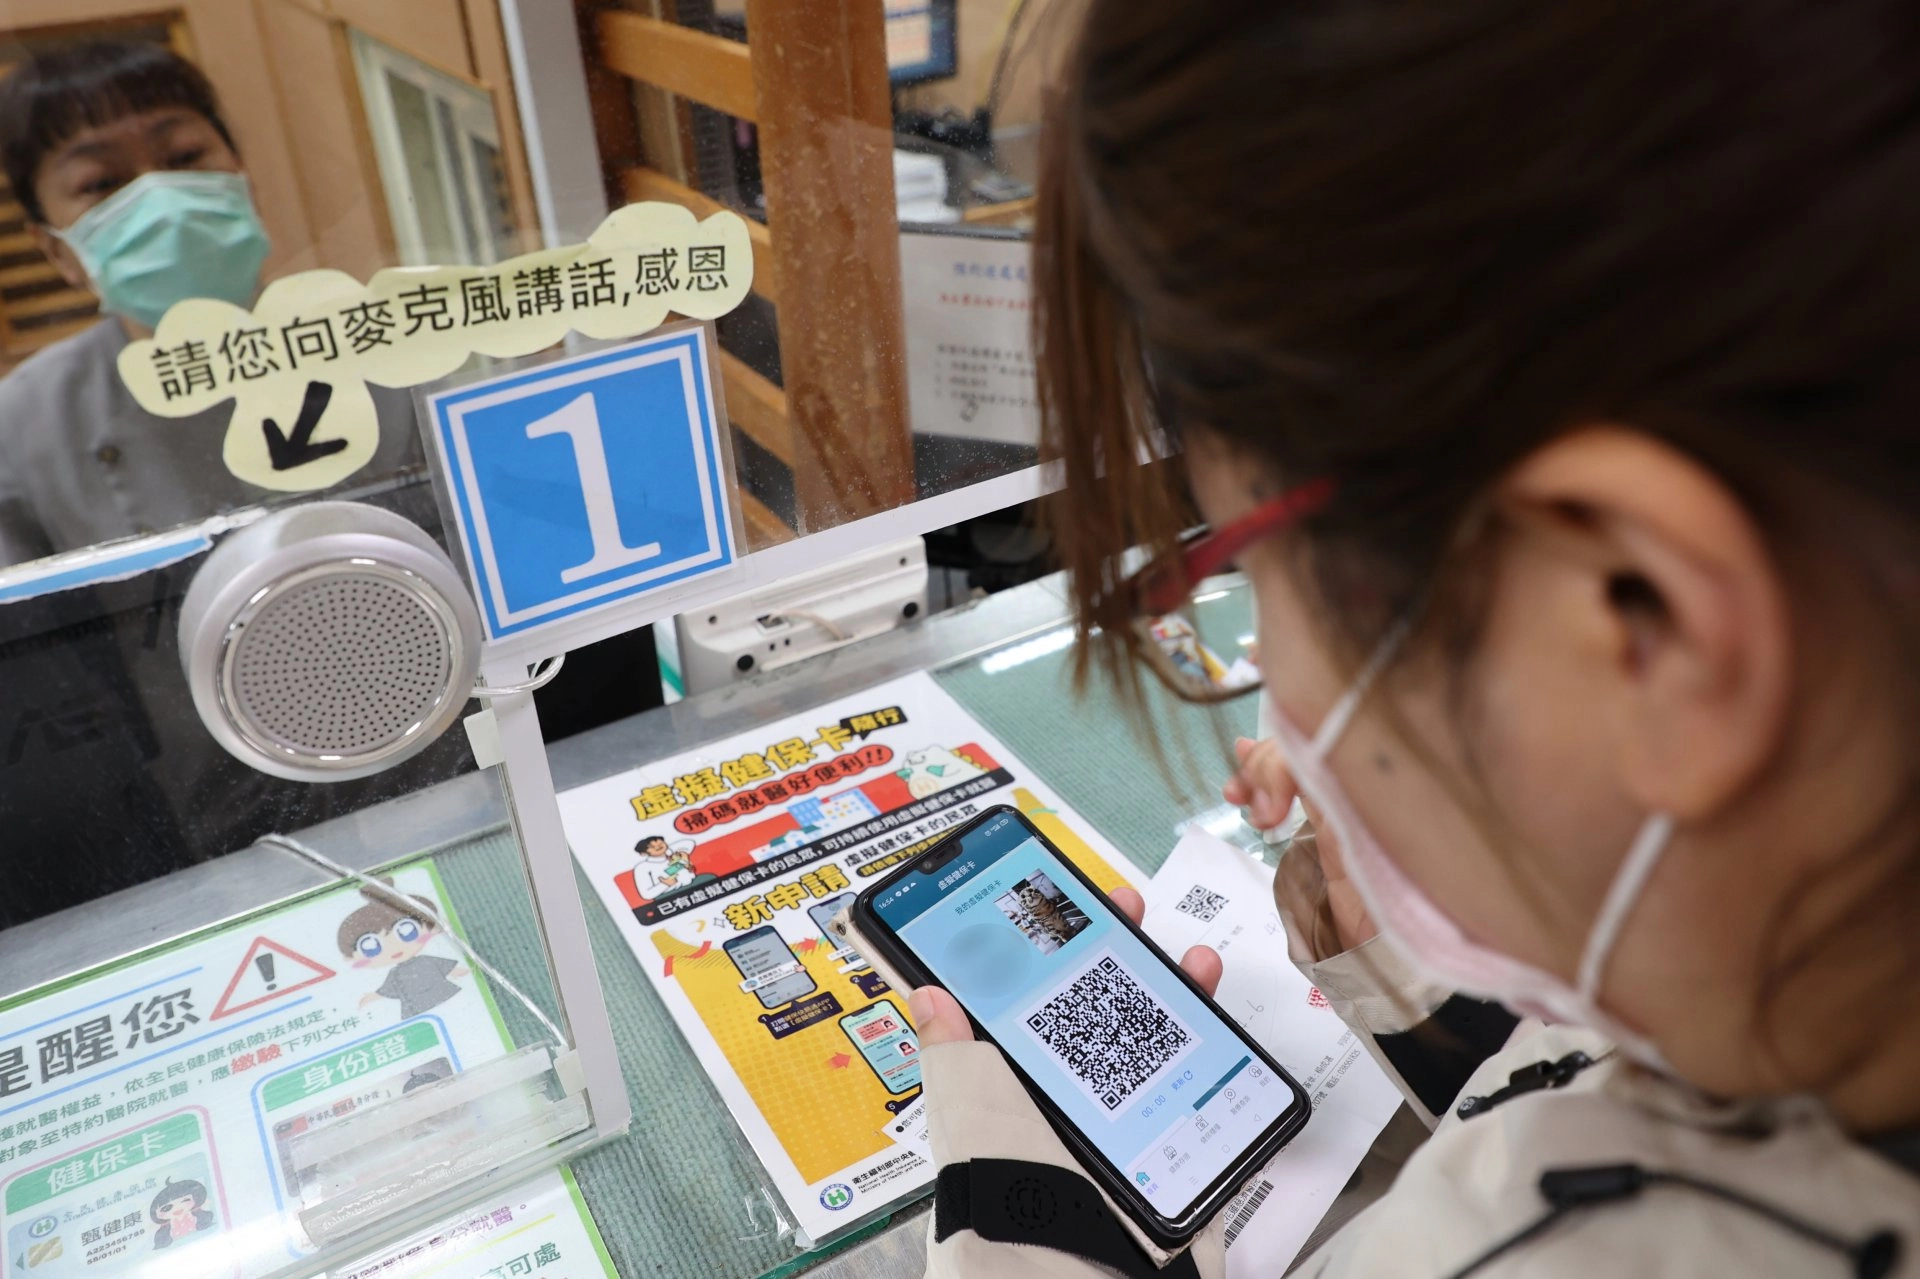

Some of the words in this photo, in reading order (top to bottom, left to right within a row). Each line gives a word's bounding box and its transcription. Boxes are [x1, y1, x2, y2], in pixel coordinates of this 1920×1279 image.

[525, 391, 662, 585] 1
[851, 707, 899, 733] 隨行
[630, 725, 853, 821] 虛擬健保卡
[682, 747, 885, 832] 掃碼就醫好便利!!
[722, 863, 851, 931] 新申請
[879, 896, 894, 910] 16:54
[938, 860, 977, 891] 虛擬健保卡
[954, 879, 1002, 916] 我的虛擬健保卡
[302, 1034, 410, 1094] 身份證
[47, 1131, 166, 1195] 健保卡
[80, 1210, 144, 1247] 甄健康
